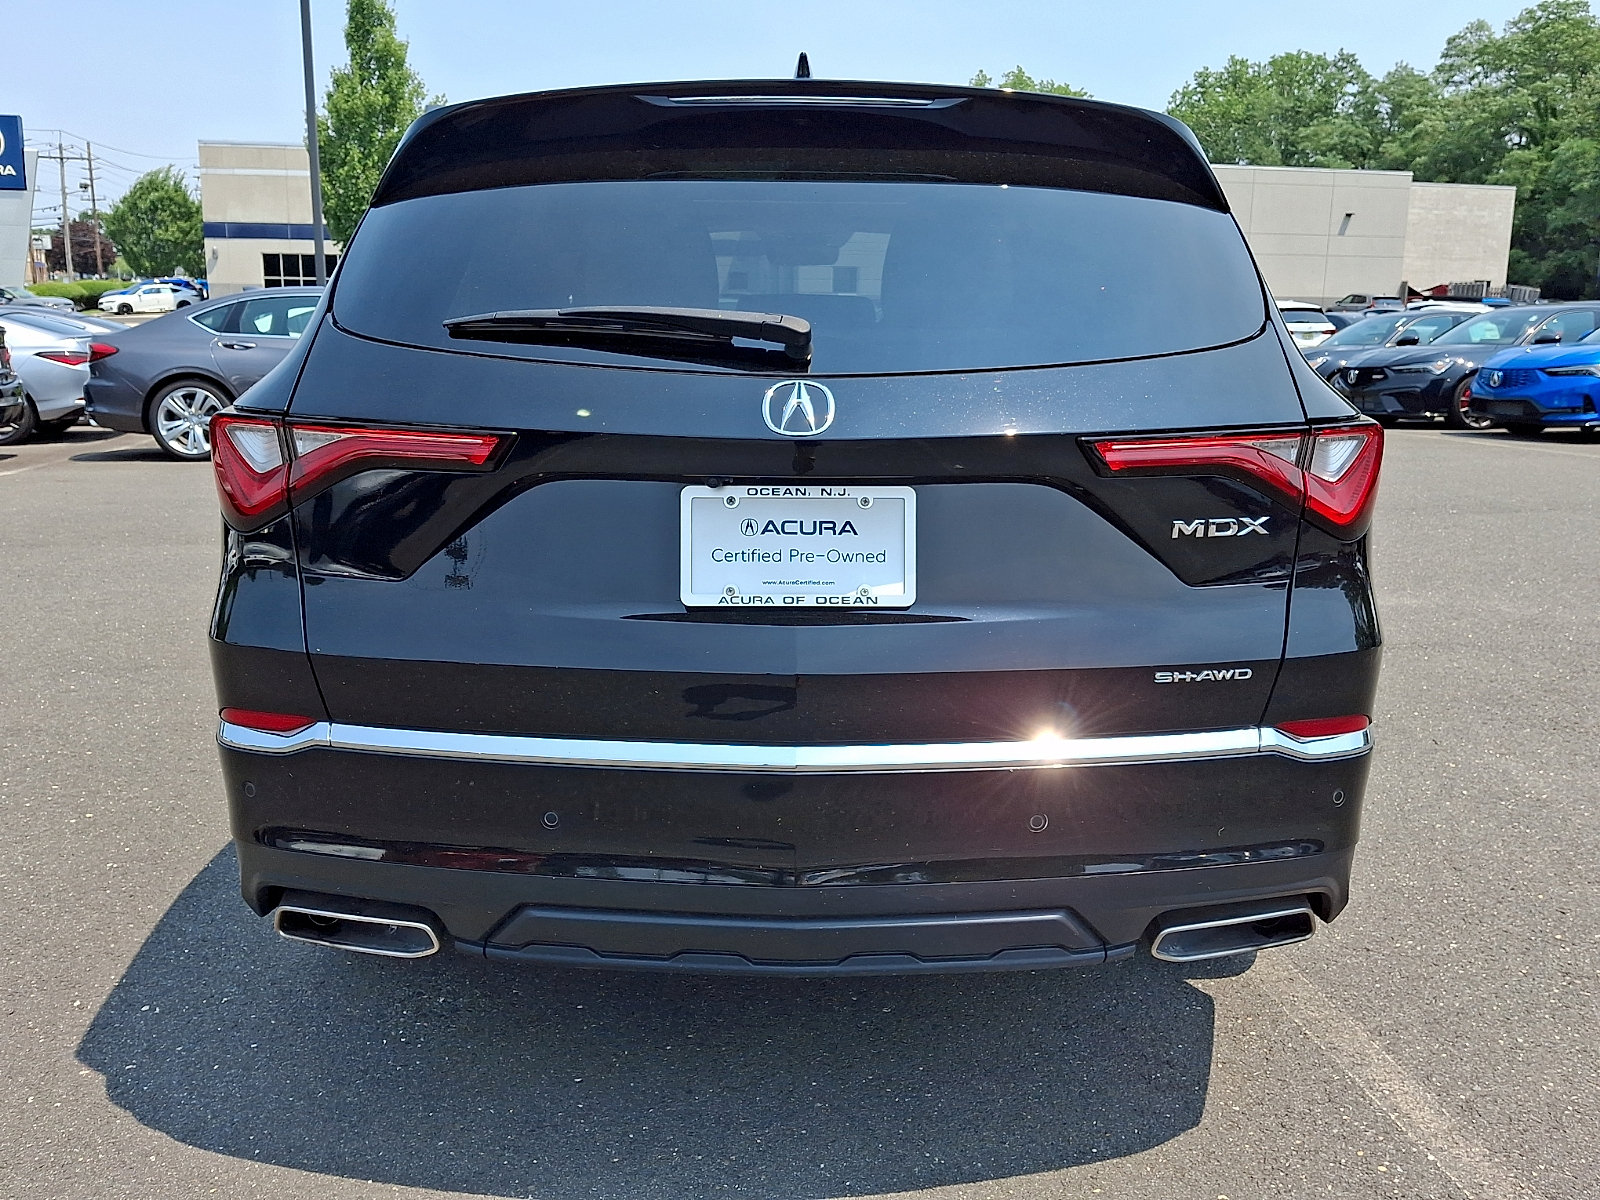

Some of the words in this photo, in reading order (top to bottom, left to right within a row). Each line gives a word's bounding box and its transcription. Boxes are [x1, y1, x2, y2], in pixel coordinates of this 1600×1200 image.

[746, 487, 811, 497] OCEAN,
[820, 487, 851, 497] N.J.
[760, 520, 858, 536] ACURA
[1171, 516, 1271, 539] MDX
[711, 548, 782, 563] Certified
[789, 548, 886, 563] Pre-Owned
[762, 579, 835, 587] www.AcuraCertified.com
[717, 596, 775, 605] ACURA
[782, 596, 806, 605] OF
[815, 596, 878, 605] OCEAN
[1153, 668, 1253, 683] SH-AWD
